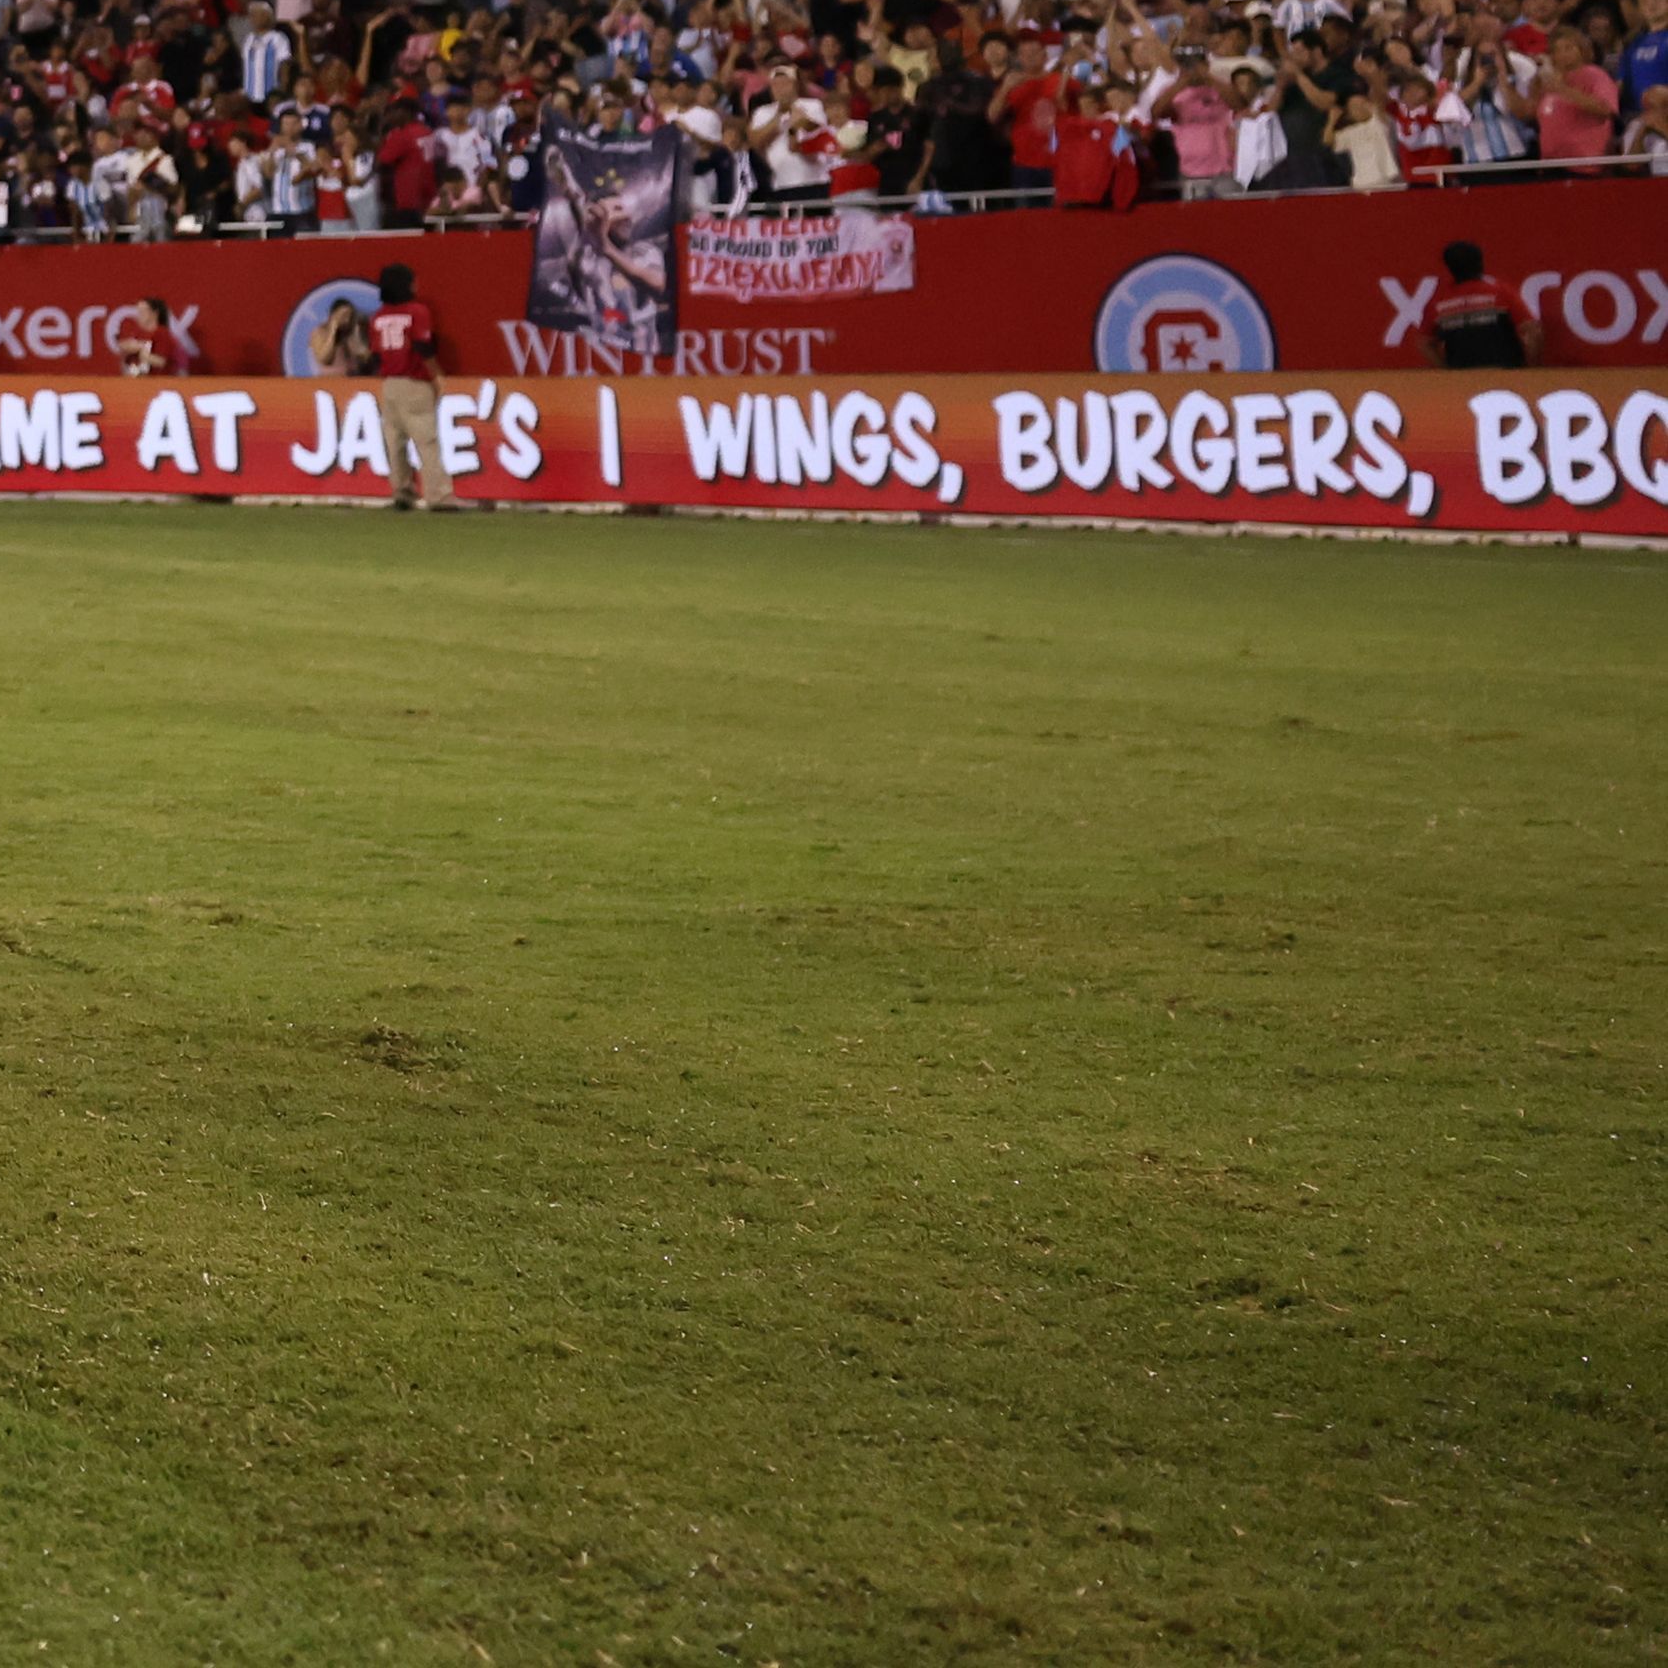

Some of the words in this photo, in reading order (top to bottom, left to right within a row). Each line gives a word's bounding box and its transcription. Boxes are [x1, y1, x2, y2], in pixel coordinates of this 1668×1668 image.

[714, 236, 773, 258] PROUD
[137, 388, 256, 475] AT
[291, 379, 543, 480] JAE'S
[680, 387, 963, 503] WINGS,
[992, 388, 1436, 517] BURGERS,
